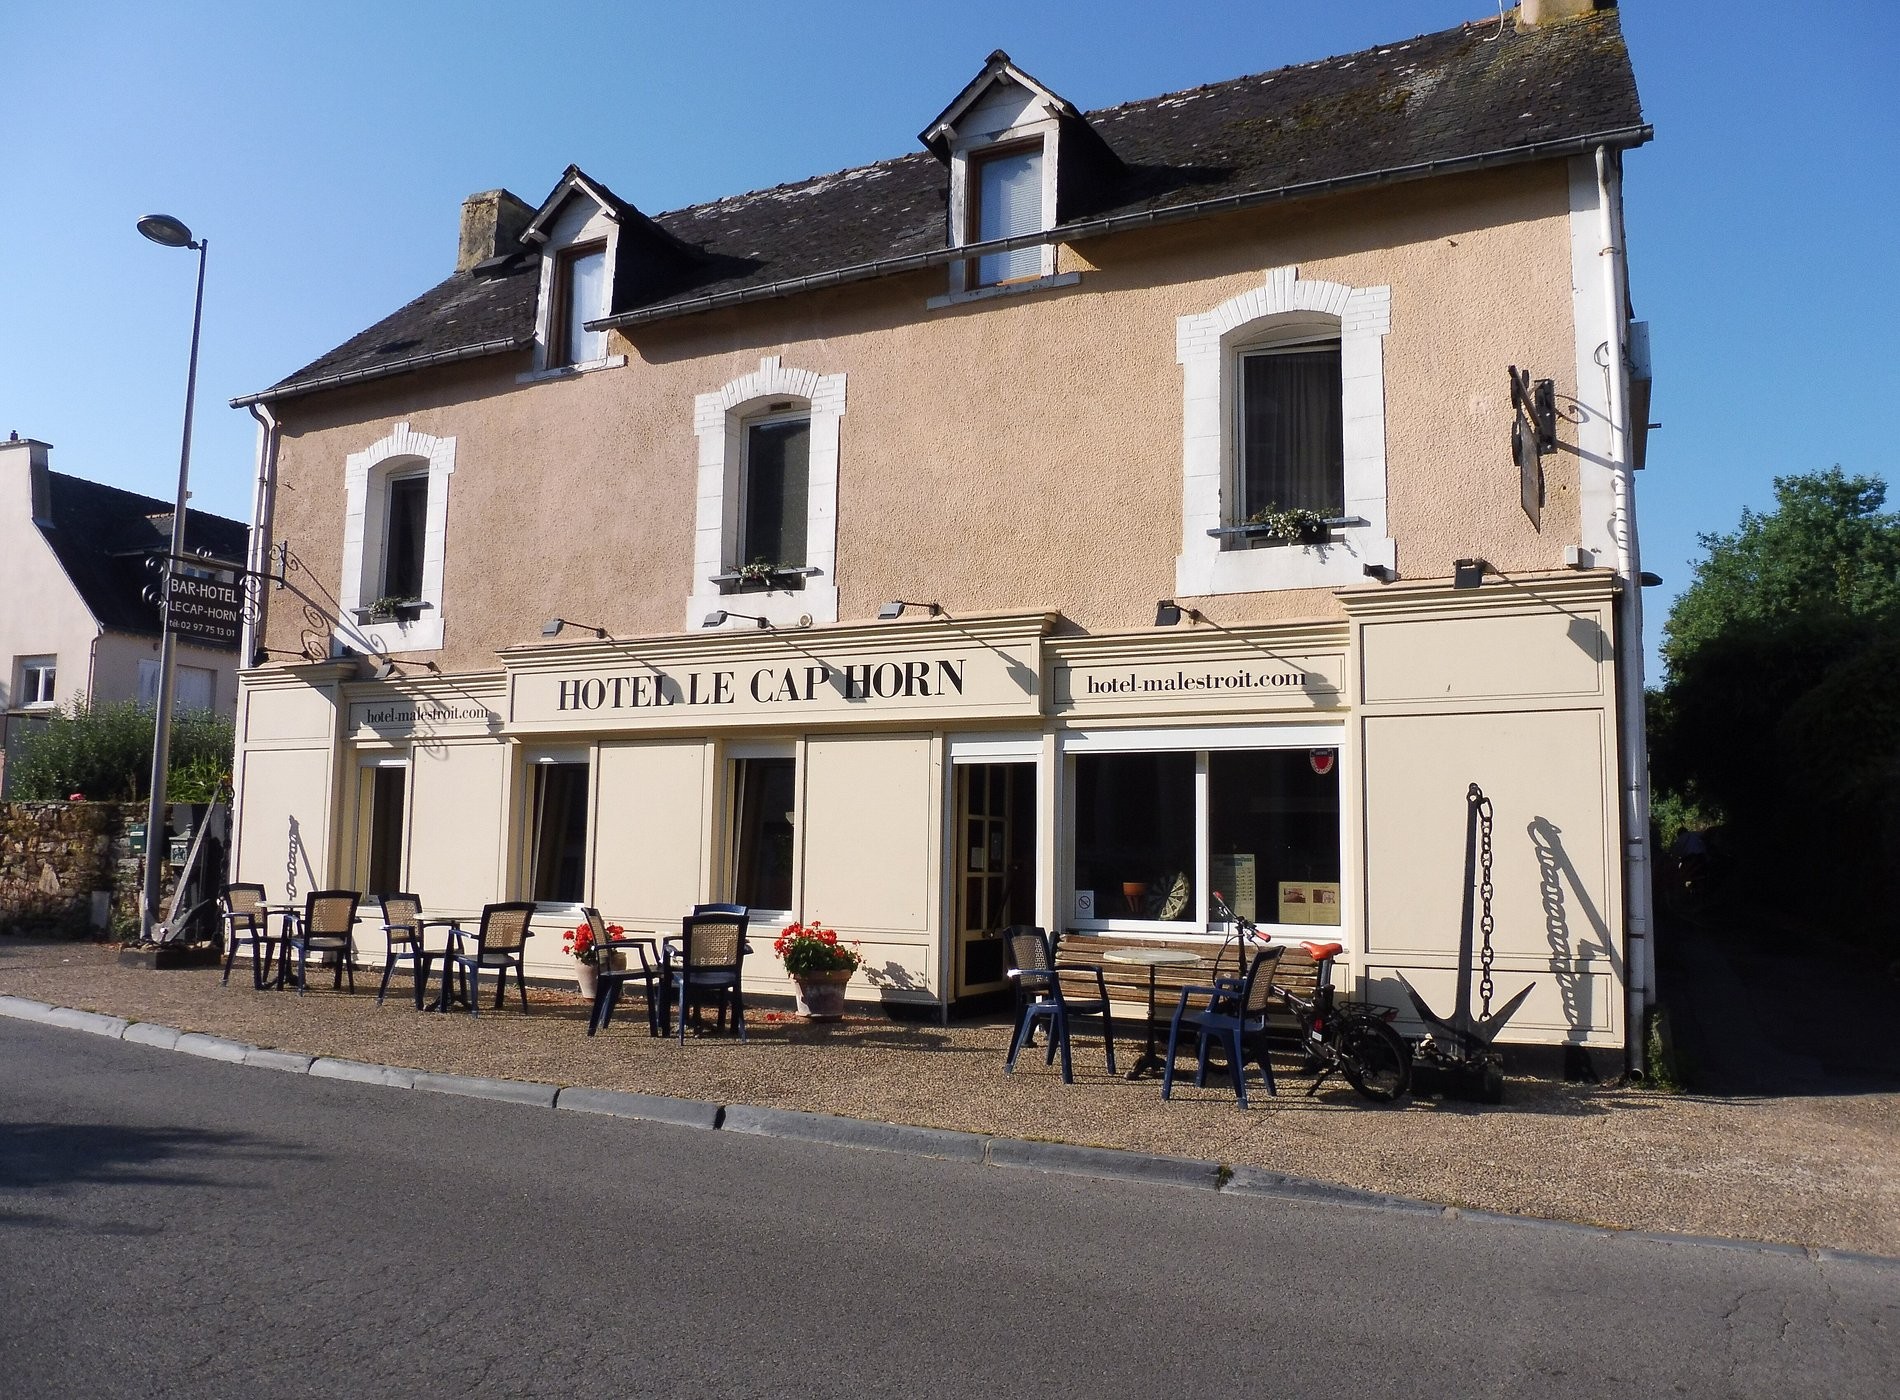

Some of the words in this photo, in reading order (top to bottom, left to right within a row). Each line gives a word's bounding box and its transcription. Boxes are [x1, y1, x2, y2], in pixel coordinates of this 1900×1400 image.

[171, 579, 238, 603] BAR-HOTEL
[180, 621, 191, 630] 02
[193, 623, 204, 632] 97
[205, 625, 215, 634] 75
[216, 627, 225, 636] 13
[226, 629, 235, 637] 01
[556, 673, 675, 711] HOTEL
[687, 671, 735, 705] LE
[750, 667, 830, 704] CAP
[842, 659, 967, 700] HORN
[1086, 669, 1308, 694] hotel-malestroit.com
